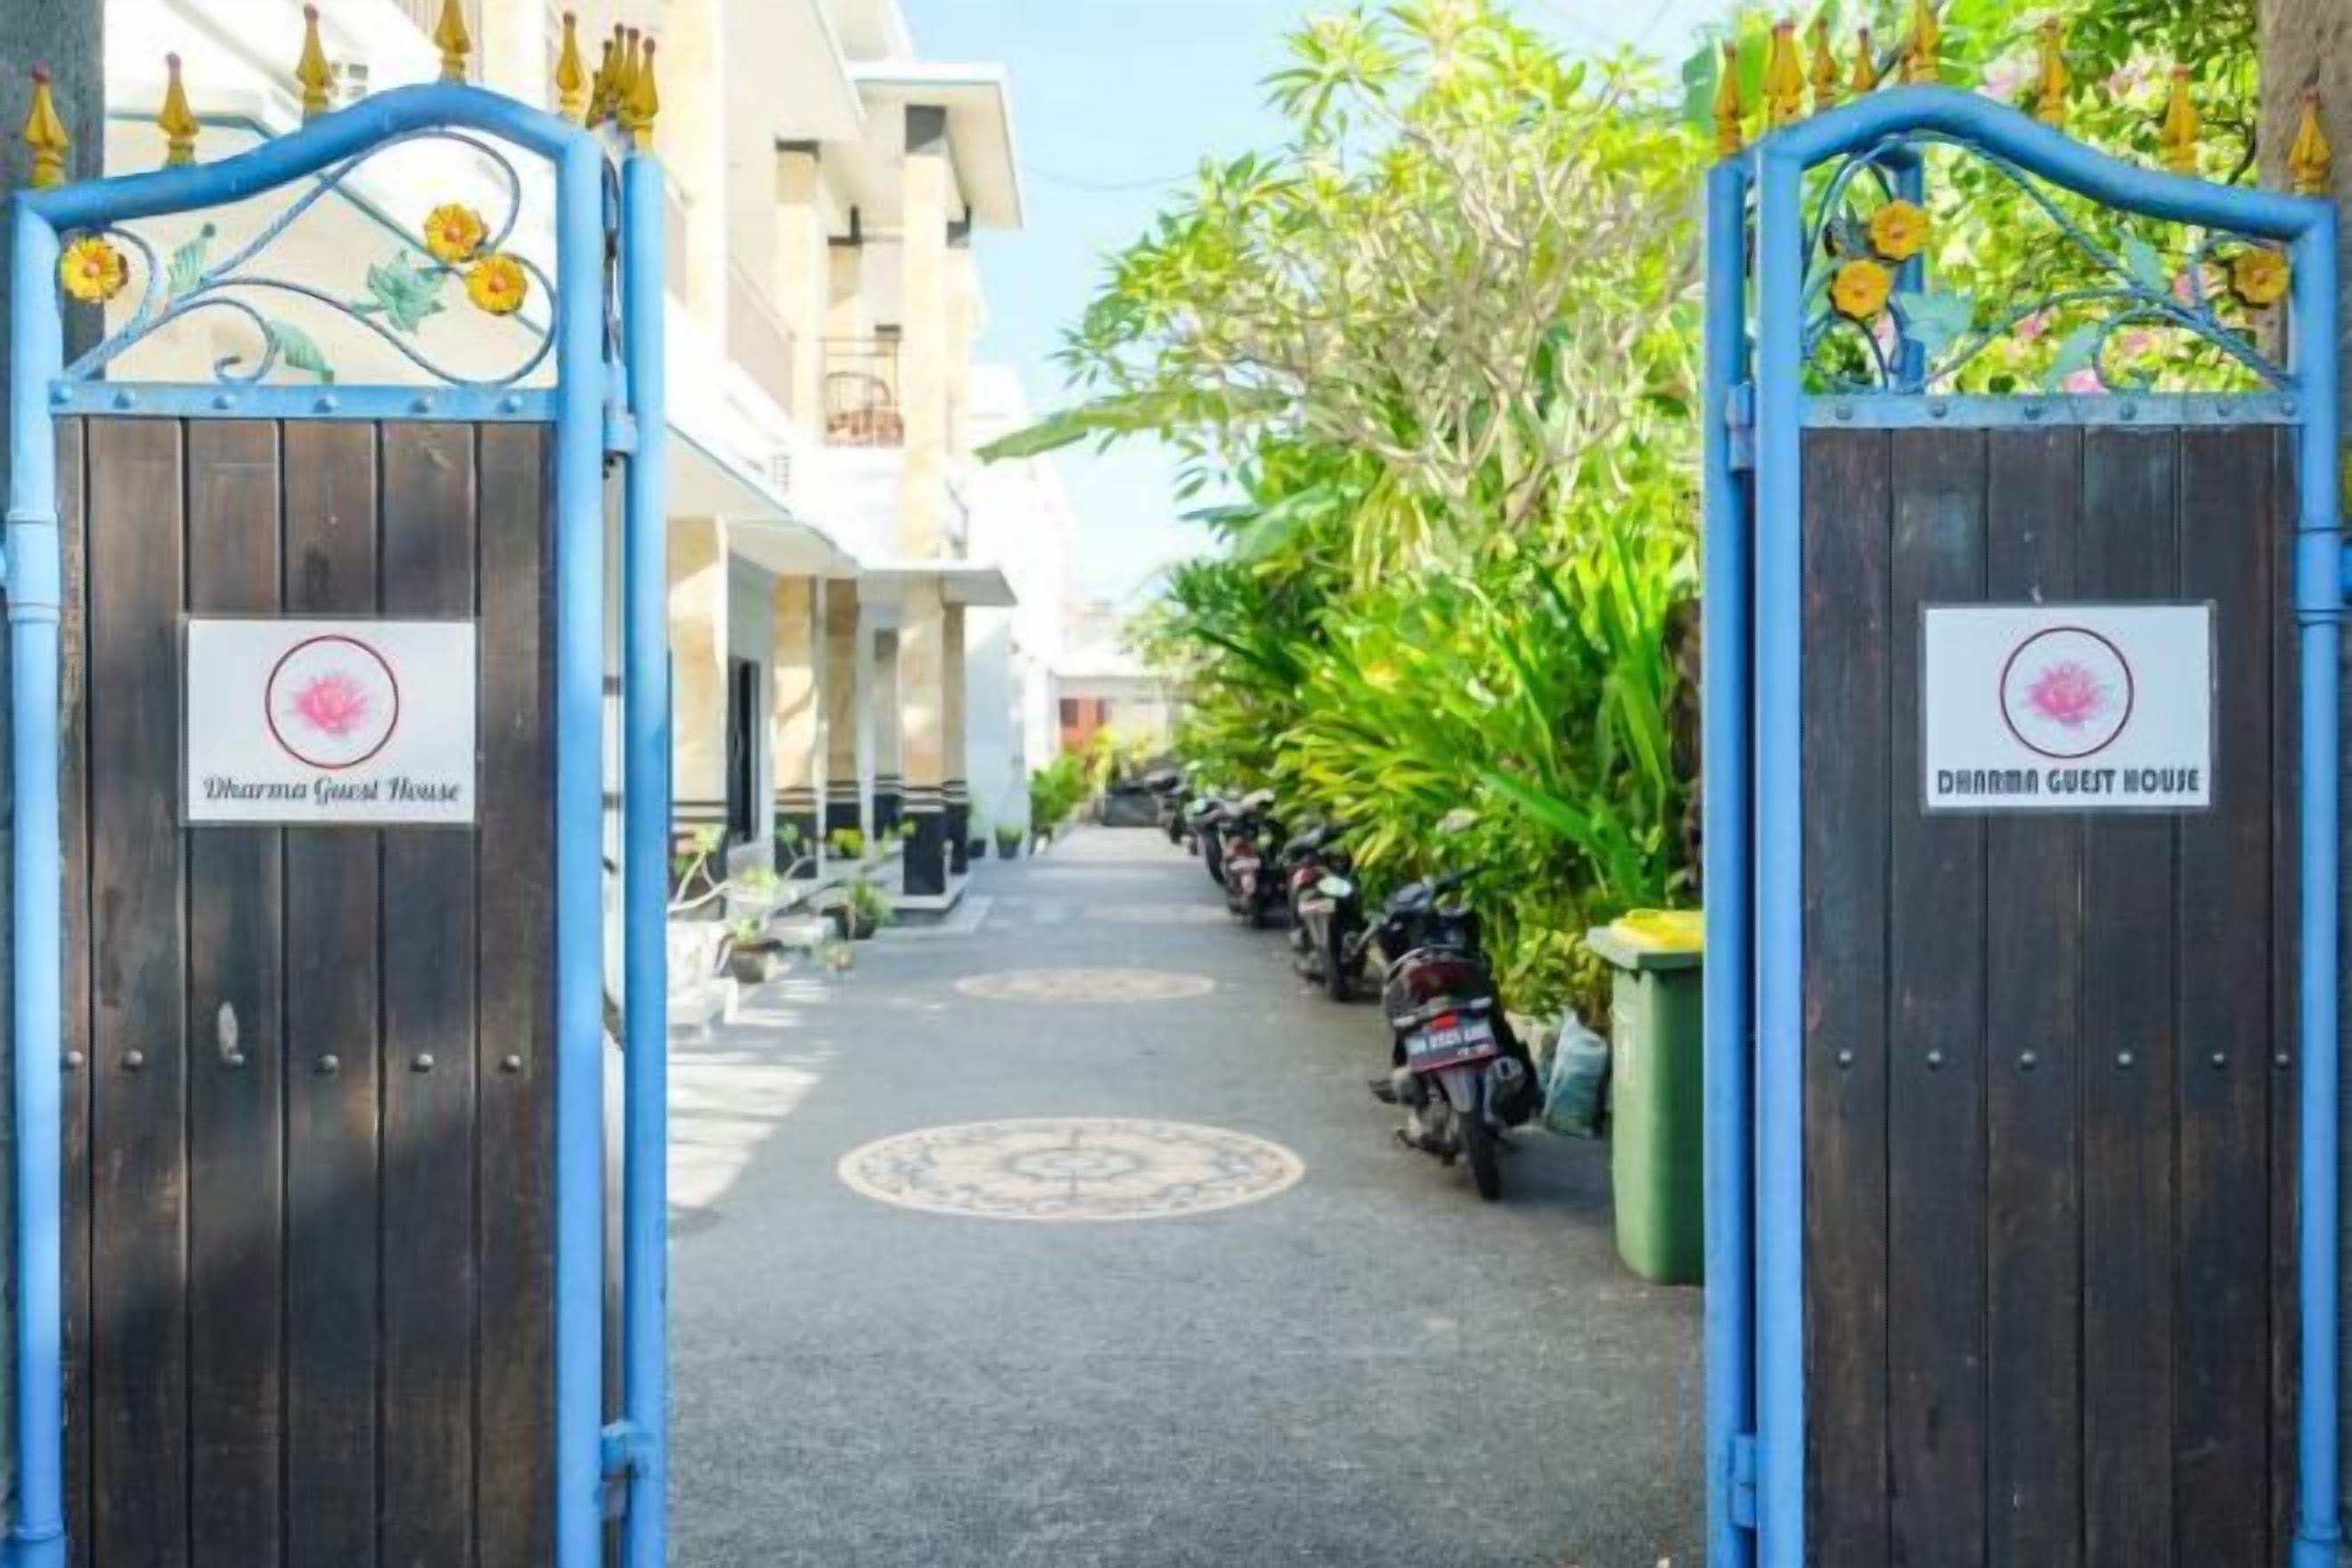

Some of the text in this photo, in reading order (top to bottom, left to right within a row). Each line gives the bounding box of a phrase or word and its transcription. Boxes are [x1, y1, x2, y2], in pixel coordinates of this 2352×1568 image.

[203, 776, 460, 804] Dharma Guest House
[1937, 769, 2200, 795] DHARMA GUEST HOUSE
